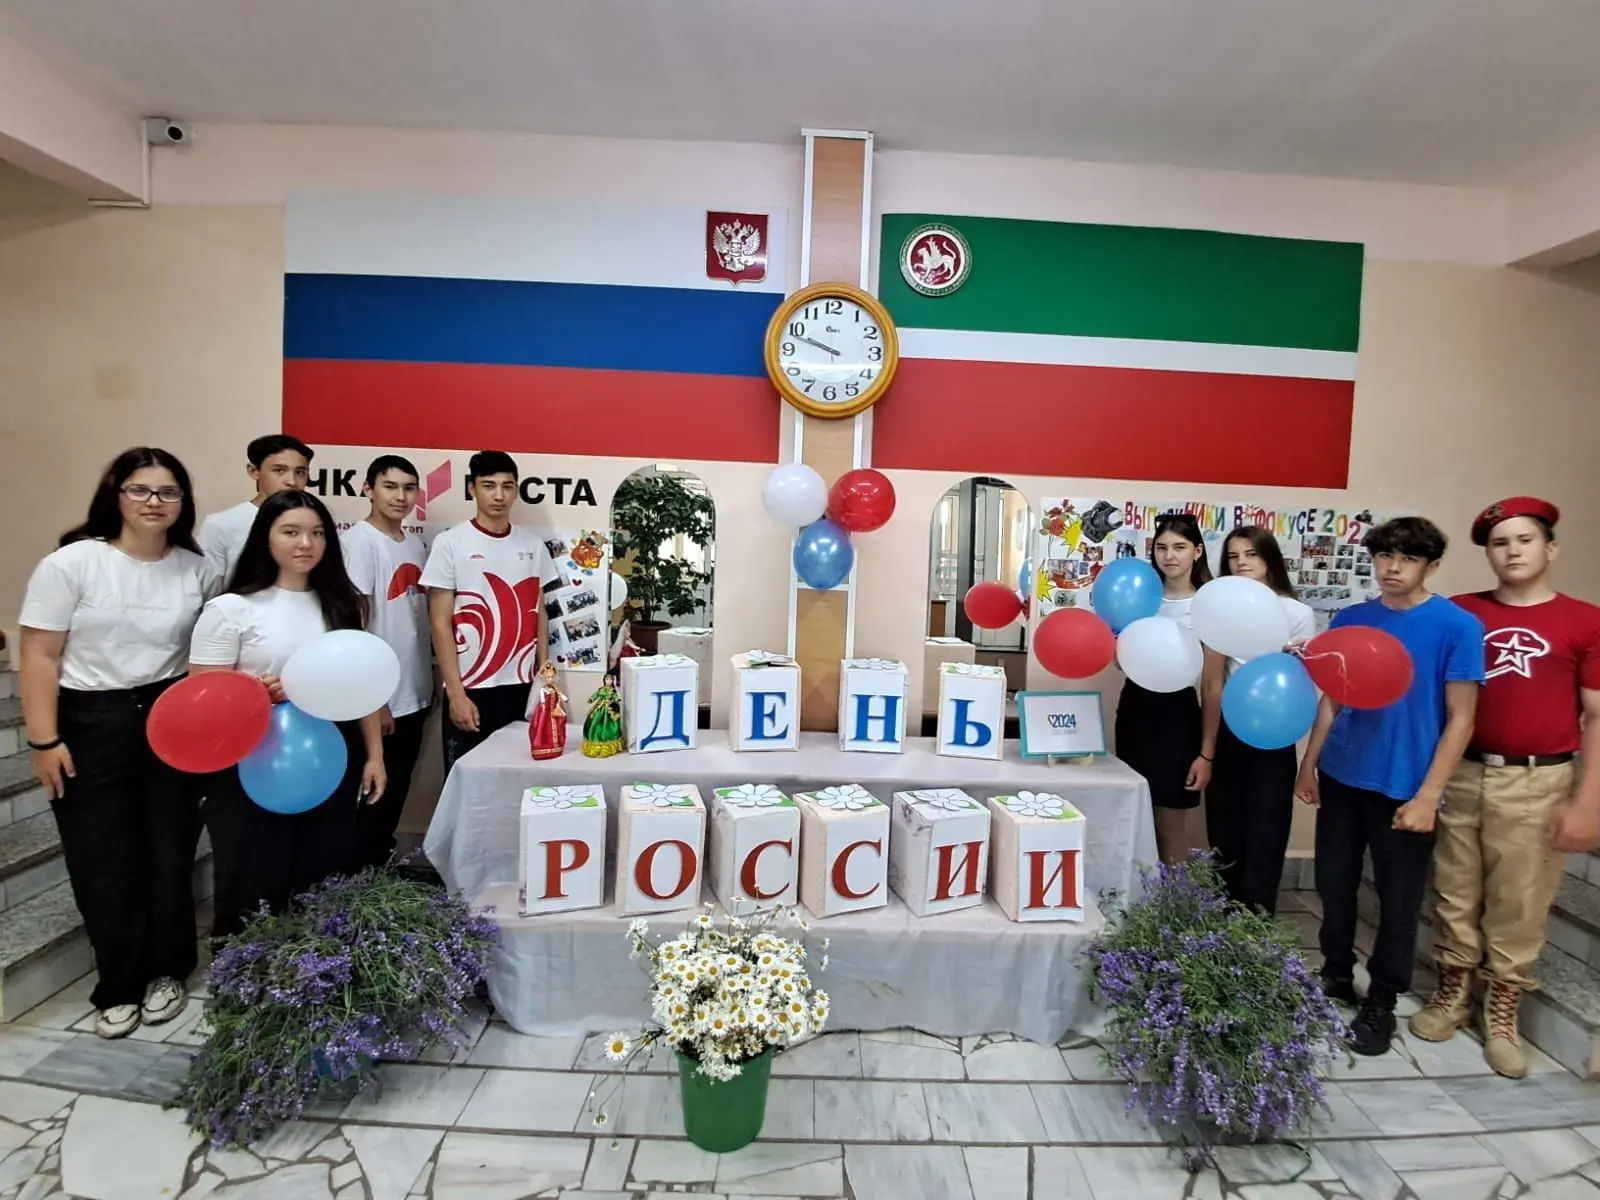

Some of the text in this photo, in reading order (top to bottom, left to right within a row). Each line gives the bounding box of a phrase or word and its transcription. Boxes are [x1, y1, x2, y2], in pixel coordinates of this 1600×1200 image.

[804, 307, 819, 321] 11
[824, 300, 844, 316] 12
[854, 309, 860, 323] 1
[788, 321, 806, 338] 10
[863, 325, 878, 341] 2
[782, 341, 796, 357] 9
[867, 346, 882, 362] 3
[859, 368, 874, 380] 4
[801, 378, 816, 393] 7
[822, 385, 837, 401] 6
[845, 381, 860, 397] 5
[305, 468, 367, 498] ЧК
[1052, 713, 1077, 729] 2024
[536, 837, 1084, 910] РОССИИ
